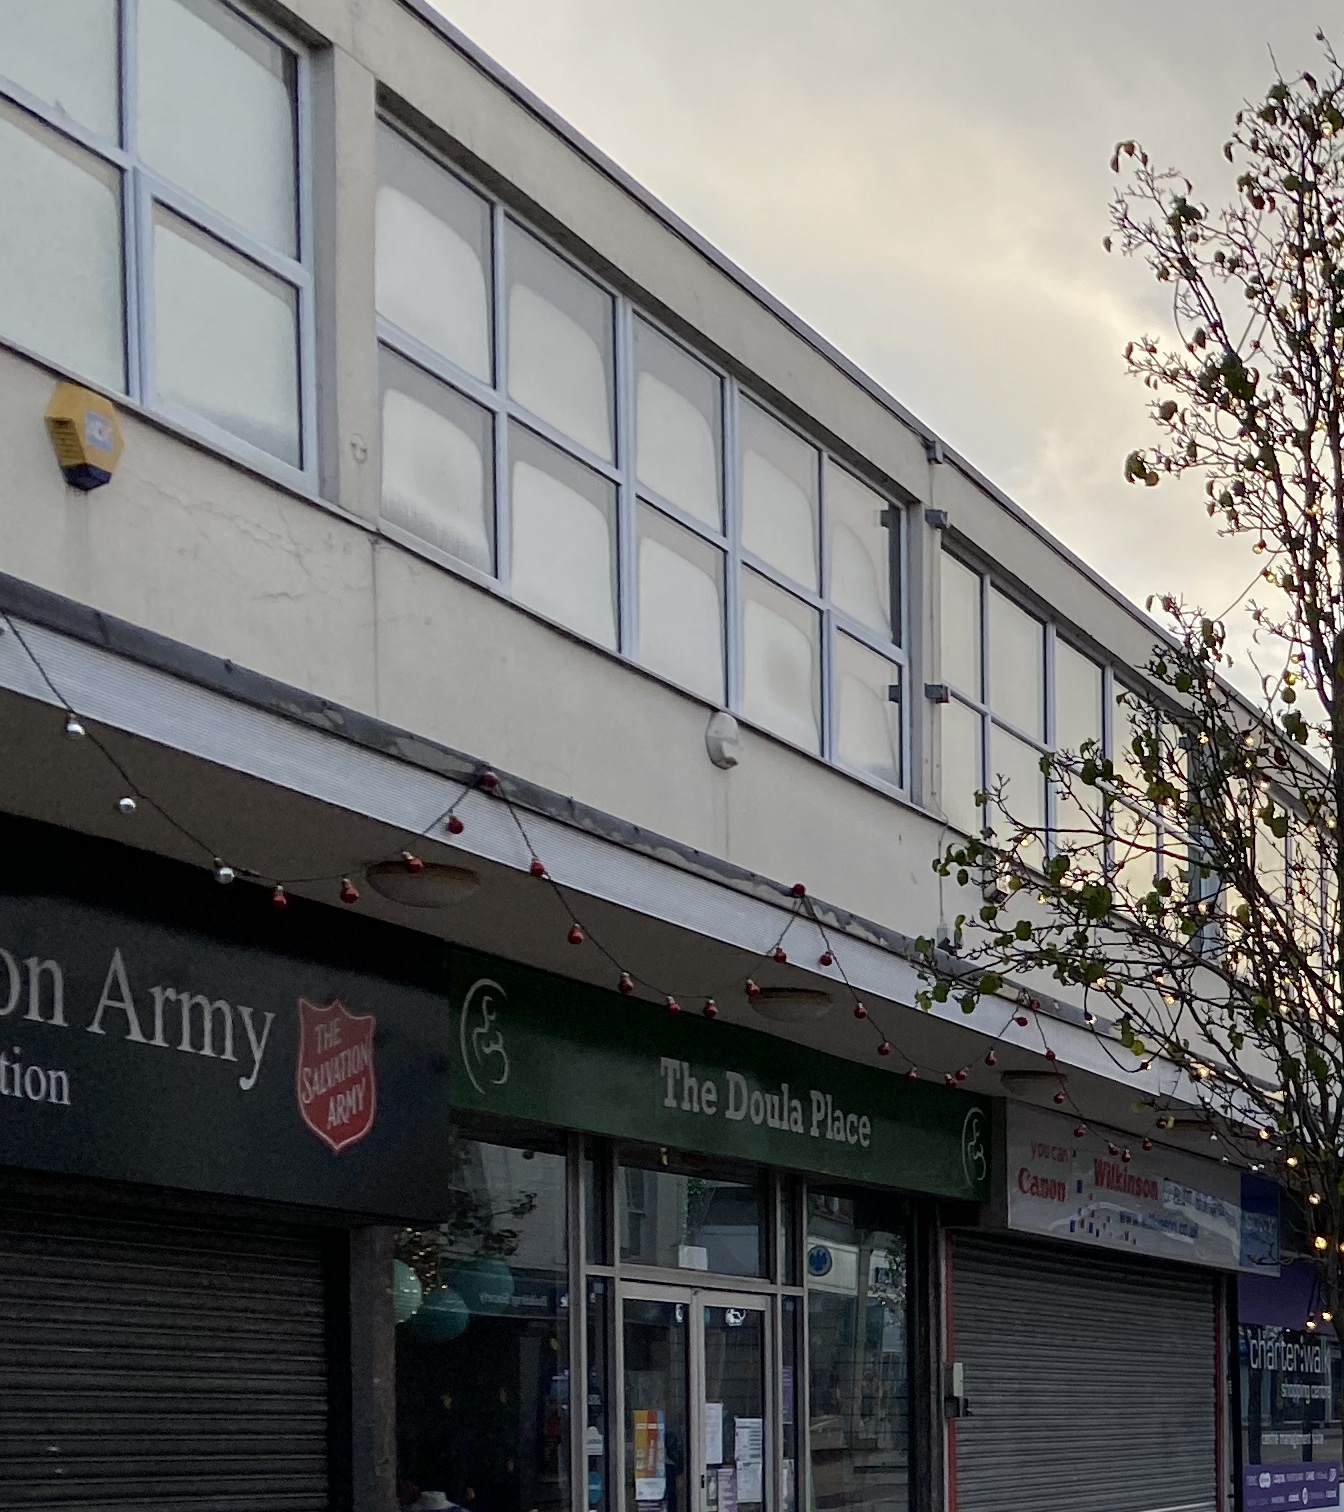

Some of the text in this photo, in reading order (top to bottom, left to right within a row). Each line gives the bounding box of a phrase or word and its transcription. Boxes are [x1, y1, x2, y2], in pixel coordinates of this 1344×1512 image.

[86, 948, 276, 1091] Army
[314, 1017, 342, 1055] THE
[301, 1036, 371, 1104] SALVATION
[327, 1076, 367, 1131] ARMY
[660, 1056, 872, 1148] The Doula Place
[1018, 1167, 1066, 1202] Canon
[1094, 1158, 1158, 1200] Wilkinson
